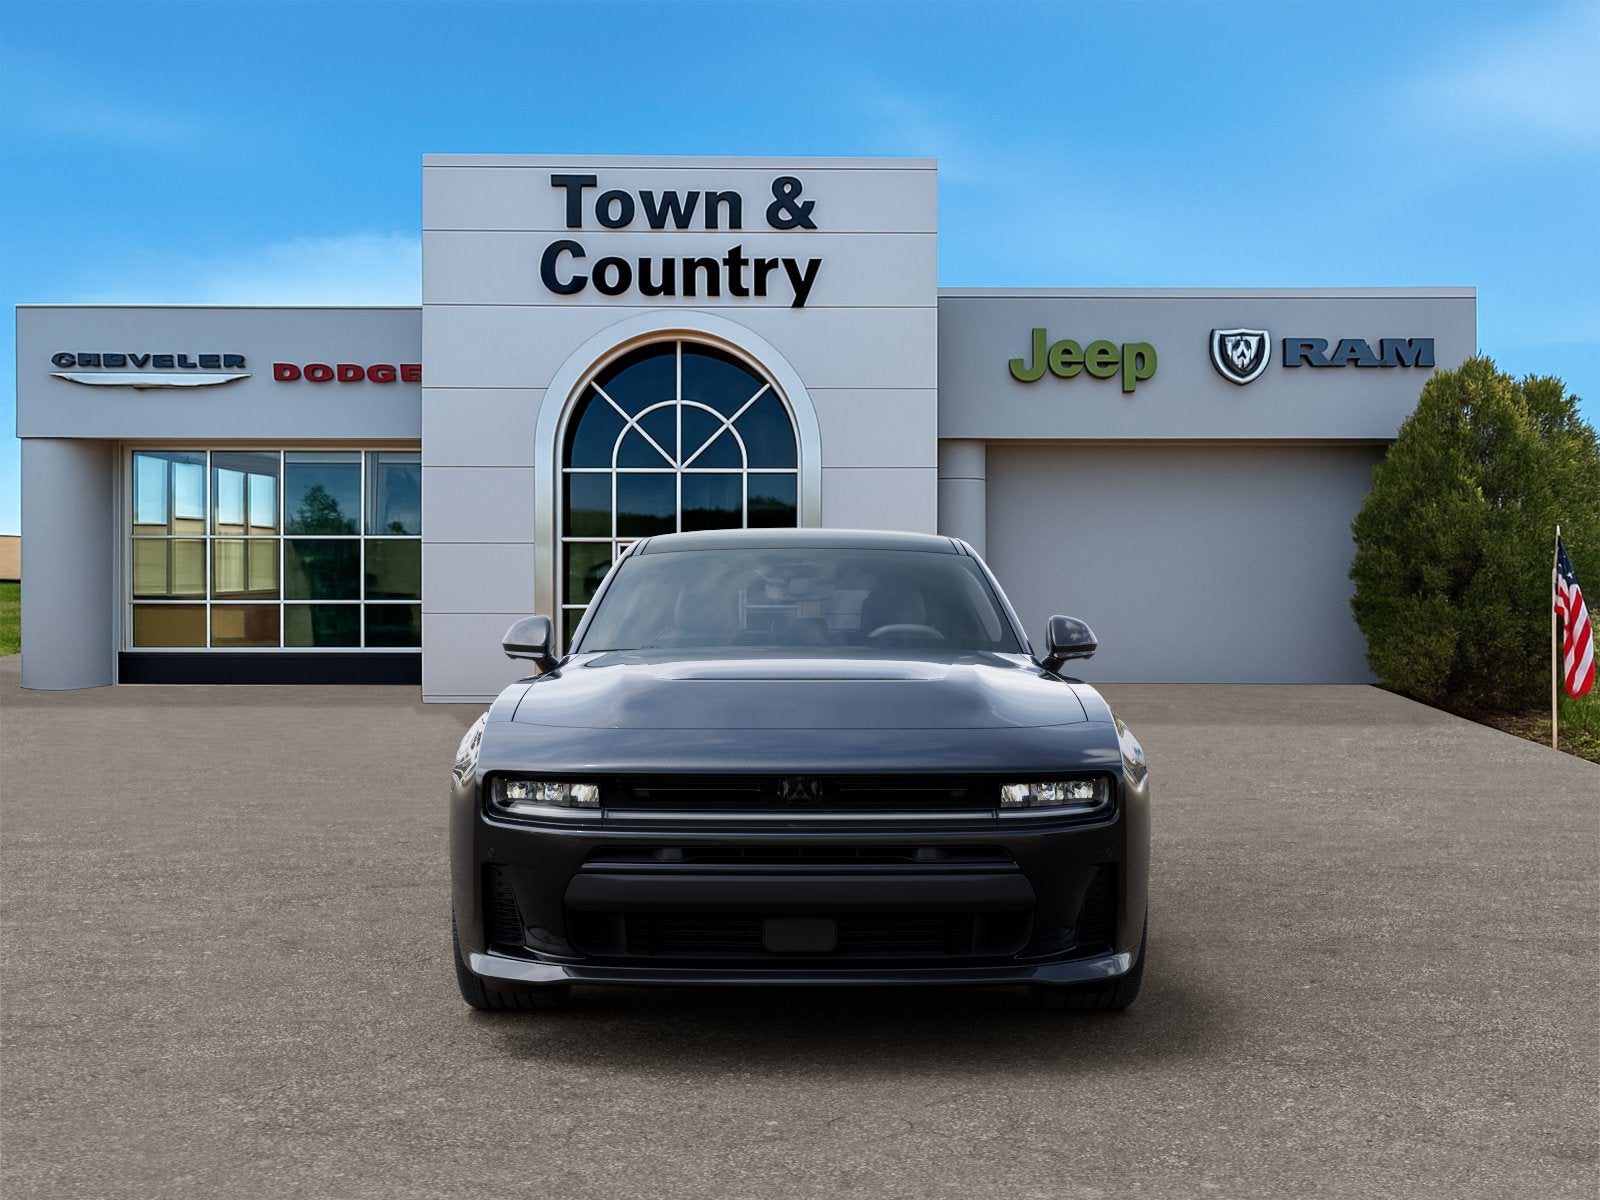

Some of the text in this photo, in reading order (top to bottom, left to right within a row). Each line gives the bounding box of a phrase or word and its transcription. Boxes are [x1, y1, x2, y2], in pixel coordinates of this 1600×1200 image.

[551, 174, 818, 229] Town &
[540, 239, 822, 308] Country
[273, 363, 422, 383] DODGE
[1009, 328, 1157, 393] Jeep
[1282, 337, 1435, 368] RAM
